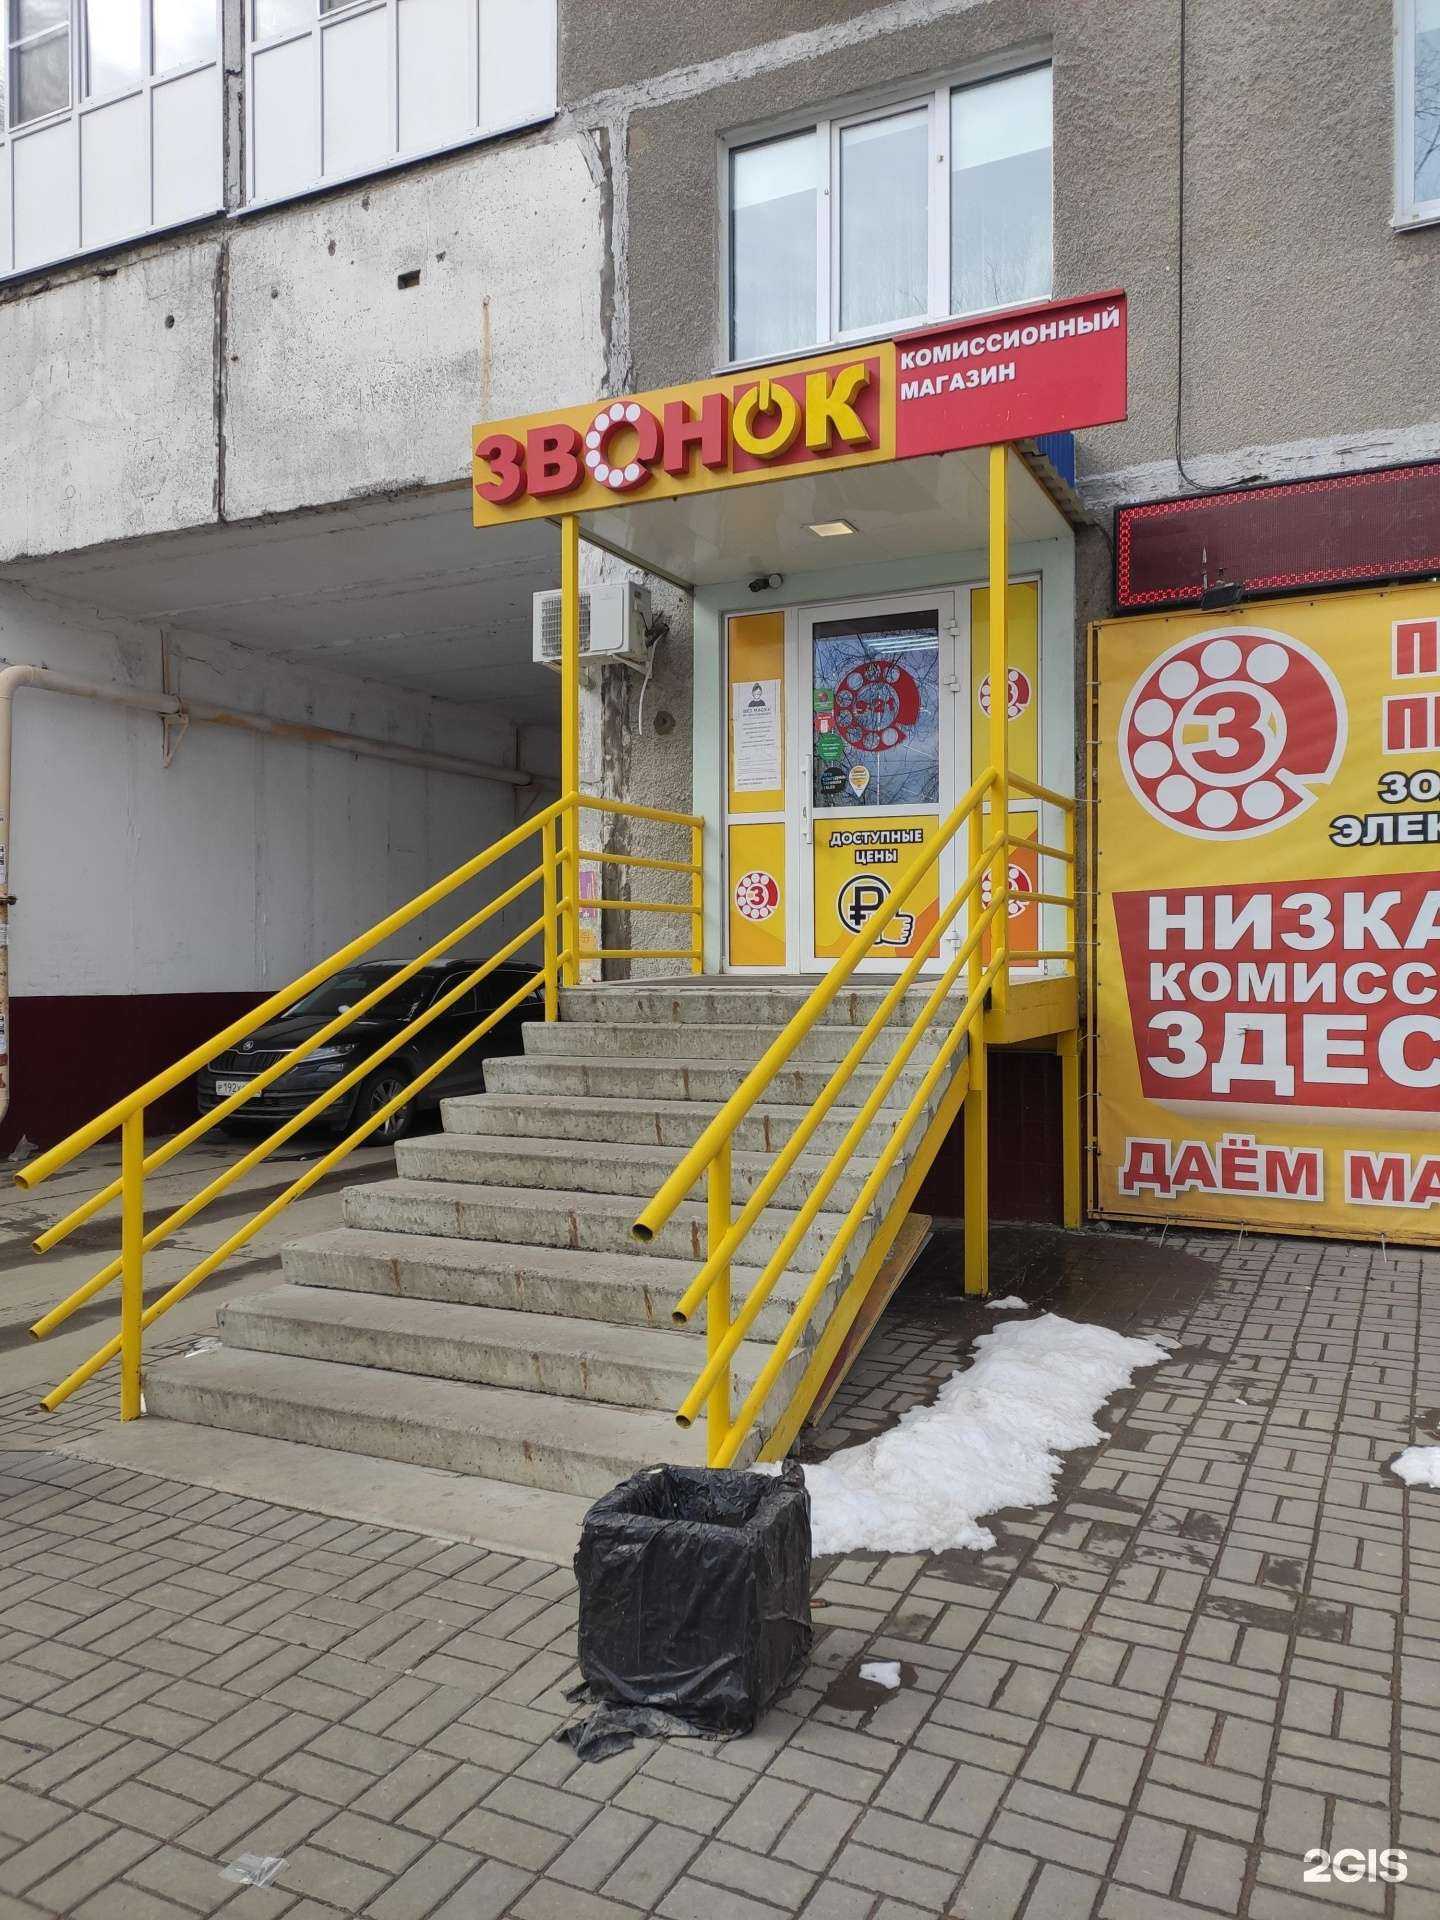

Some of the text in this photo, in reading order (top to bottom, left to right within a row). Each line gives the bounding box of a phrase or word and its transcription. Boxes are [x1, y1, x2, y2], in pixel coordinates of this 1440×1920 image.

[901, 305, 1120, 370] КОМИССИОННЫЙ
[901, 362, 1016, 400] МАГАЗИН
[475, 362, 872, 504] ЗВОНОК
[1378, 769, 1440, 804] ЗО
[829, 829, 923, 847] ДОСТУПНЫЕ
[855, 849, 898, 865] ЦЕНЫ
[1150, 961, 1437, 1005] КОМИСС
[1147, 1010, 1440, 1096] ЗДЕС
[1121, 1135, 1321, 1199] ДАЁМ
